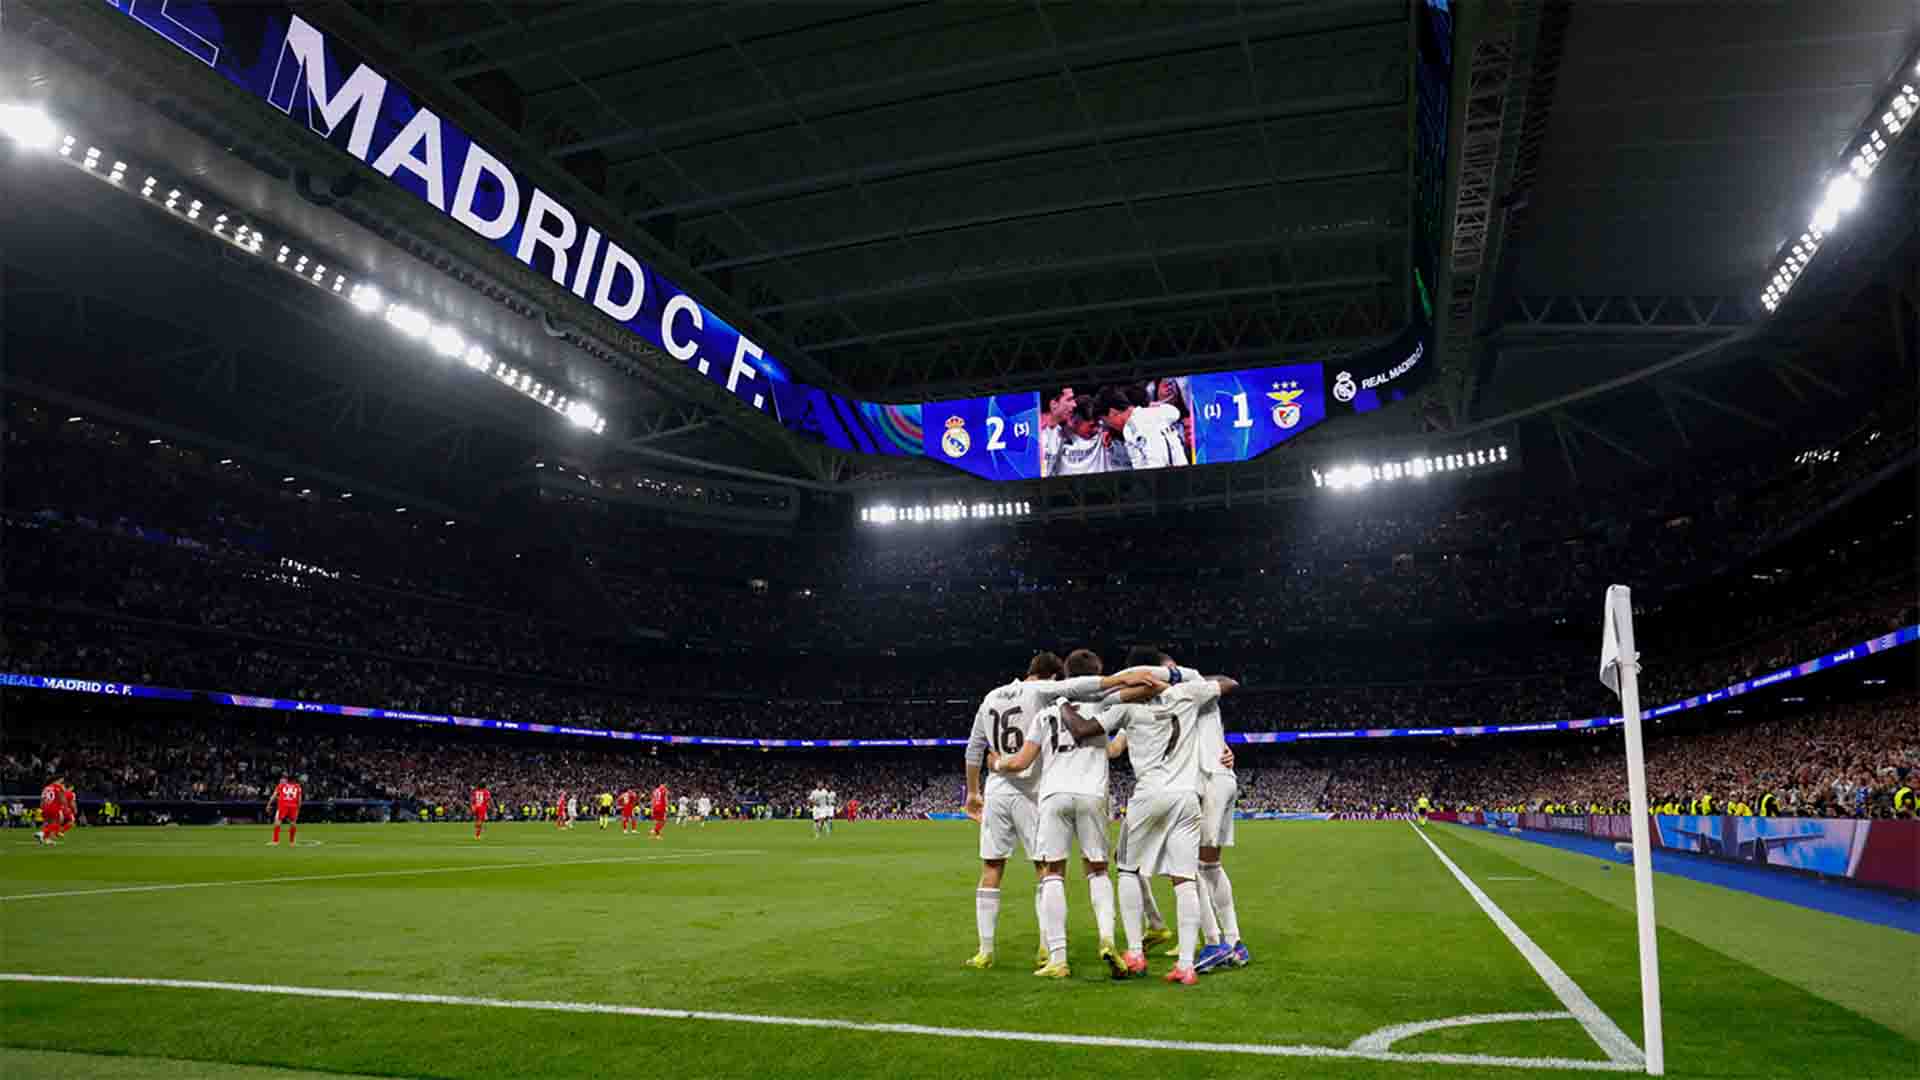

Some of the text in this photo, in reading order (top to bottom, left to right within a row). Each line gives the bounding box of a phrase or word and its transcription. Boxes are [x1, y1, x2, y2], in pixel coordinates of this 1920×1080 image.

[266, 14, 645, 322] MADRID
[661, 294, 710, 375] C.
[726, 334, 764, 409] F.
[1362, 373, 1389, 390] REAL
[1233, 392, 1253, 428] 1
[985, 416, 1006, 450] 2
[0, 673, 132, 696] REAL MADRID C. F.
[989, 705, 1024, 753] 16
[1153, 711, 1181, 761] 7
[1340, 812, 1376, 821] QATAR
